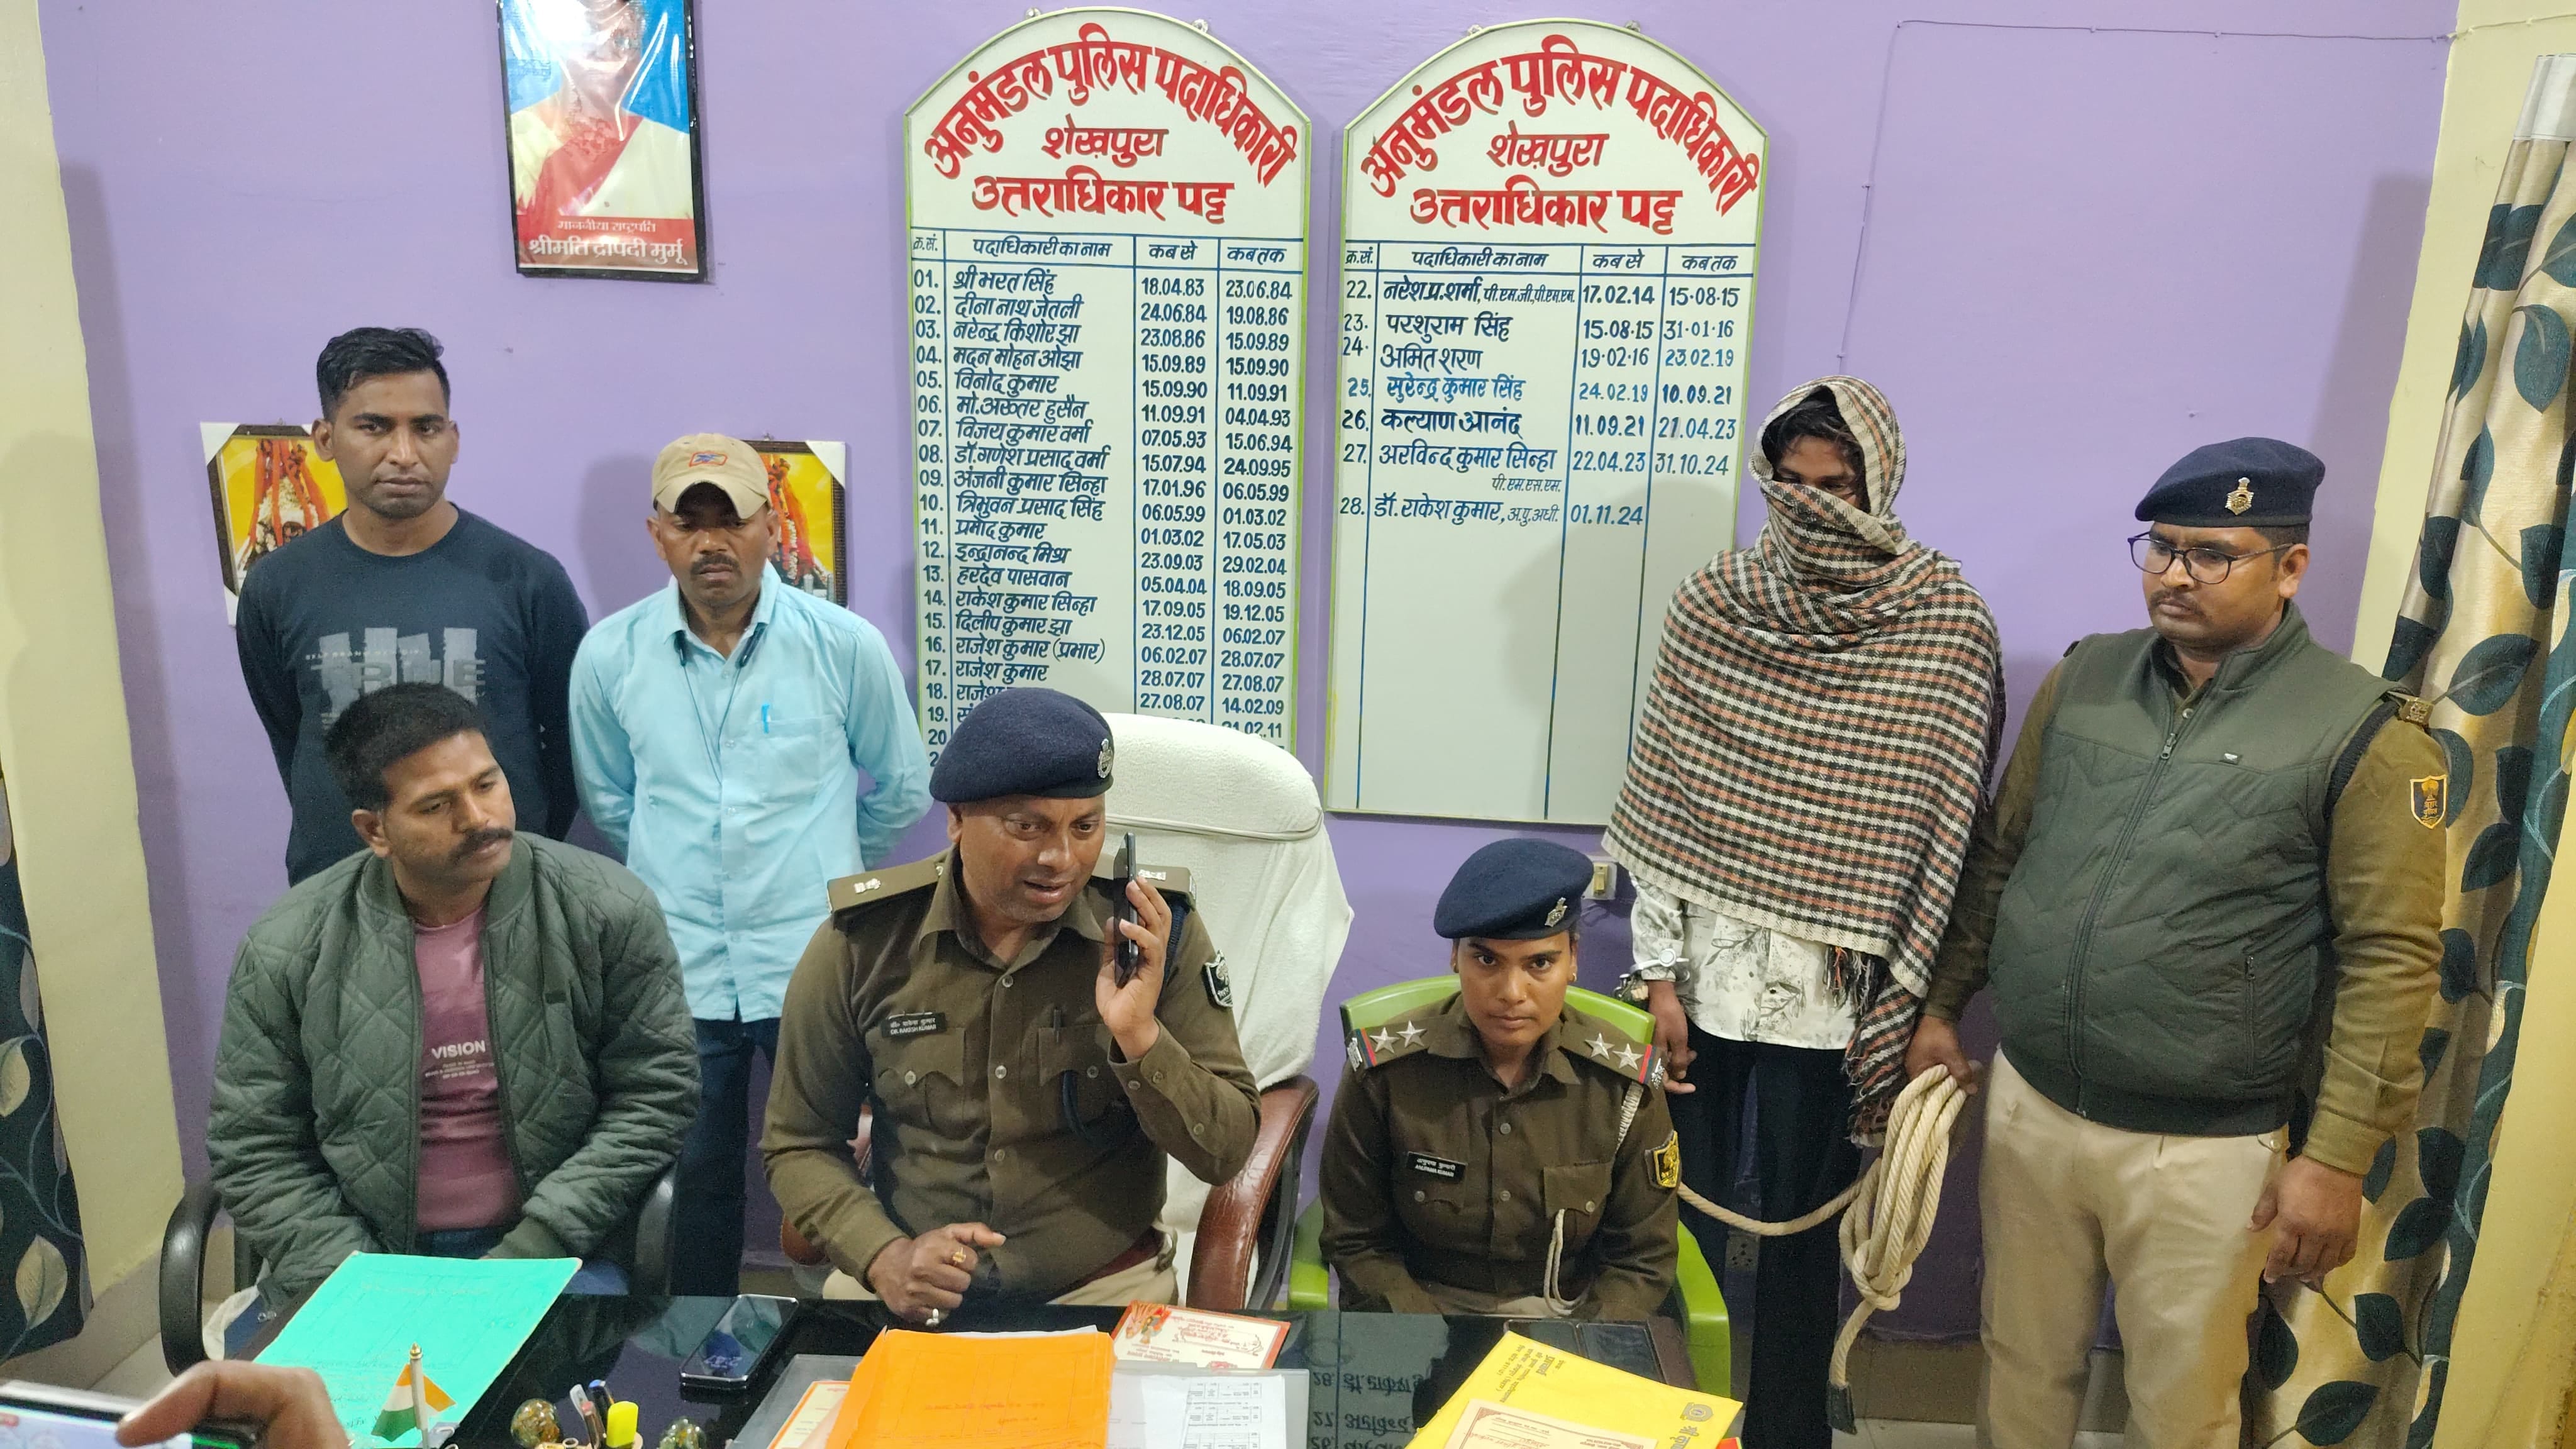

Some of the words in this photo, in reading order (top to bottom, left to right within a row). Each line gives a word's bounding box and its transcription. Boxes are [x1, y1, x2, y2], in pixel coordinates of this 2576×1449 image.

[924, 50, 1054, 180] अनुमंडल
[1046, 23, 1153, 106] पुलिस
[1155, 47, 1297, 187] पदाधिकारी
[1361, 59, 1504, 198] अनुमंडल
[1501, 34, 1629, 118] पुलिस
[1626, 66, 1759, 217] पदाधिकारी
[972, 165, 1169, 221] उत्तराधिकार
[1411, 175, 1613, 233] उत्तराधिकार
[529, 234, 588, 255] श्रीमति
[650, 238, 688, 265] मुर्मू
[973, 235, 1060, 257] पदाधिकारी
[1081, 243, 1113, 257] नाम
[1148, 244, 1180, 259] कब
[1180, 240, 1197, 260] से
[1228, 247, 1258, 262] कब
[1257, 248, 1287, 265] तक
[1412, 247, 1493, 268] पदाधिकारी
[1515, 253, 1549, 267] नाम
[1592, 254, 1626, 268] कब
[1625, 248, 1645, 268] से
[1682, 255, 1713, 270] कब
[1711, 255, 1738, 272] तक
[914, 269, 939, 288] 01.
[953, 265, 977, 289] श्री
[979, 271, 1022, 293] भरत
[1023, 268, 1057, 294] सिंह
[1141, 277, 1204, 296] 18.04.83
[1226, 280, 1292, 299] 23.06.84
[1346, 280, 1372, 299] 22.
[1583, 286, 1655, 304] 17.02.14
[954, 291, 997, 318] दीना
[996, 298, 1035, 316] नाथ
[916, 319, 940, 339] 03.
[953, 318, 1002, 341] नरेन्द्र
[1004, 318, 1057, 343] किशोर
[1056, 325, 1082, 345] झा
[1345, 314, 1368, 331] 23.
[1386, 314, 1468, 343] परशुराम
[1474, 311, 1513, 342] सिंह
[1141, 328, 1206, 348] 23.08.86
[1226, 332, 1289, 352] 15.09.89
[953, 347, 994, 367] मदन
[994, 343, 1038, 370] मोहन
[1038, 345, 1083, 371] ओझा
[1380, 343, 1438, 372] अमित
[1439, 348, 1484, 374] शरण
[1665, 348, 1733, 367] 23.02.19
[916, 370, 941, 389] 05.
[955, 367, 1007, 394] विनोद
[1007, 374, 1060, 397] कुमार
[1142, 380, 1208, 398] 15.09.90
[1348, 377, 1371, 397] 25.
[1387, 372, 1440, 403] सुरेन्द्र
[1441, 378, 1489, 404] कुमार
[1492, 374, 1526, 401] सिंह
[1228, 383, 1287, 402] 11.09.91
[1580, 382, 1648, 402] 24.02.19
[1663, 384, 1731, 404] 10.09.21
[1044, 394, 1089, 424] हुसैन
[1342, 409, 1368, 431] 26.
[1381, 408, 1458, 433] कल्याण
[1459, 407, 1523, 440] आनंद
[1576, 414, 1644, 436] 11.09.21
[1658, 416, 1736, 439] 21.04.23
[956, 416, 1008, 440] विजय
[1006, 423, 1060, 447] कुमार
[1060, 419, 1094, 443] वर्मा
[1024, 449, 1077, 470] प्रसाद
[1075, 445, 1111, 469] वर्मा
[1343, 443, 1367, 464] 27.
[1379, 438, 1456, 470] अरविन्द
[1457, 447, 1504, 473] कुमार
[1506, 441, 1557, 471] सिन्हा
[1573, 450, 1645, 472] 22.04.23
[1655, 453, 1729, 475] 31.10.24
[920, 469, 944, 487] 09.
[954, 465, 1007, 489] अंजनी
[1006, 472, 1057, 496] कुमार
[1058, 470, 1108, 496] सिन्हा
[1143, 479, 1206, 498] 17.01.96
[1223, 482, 1289, 502] 06.05.99
[956, 490, 1019, 518] त्रिभुवन
[1016, 497, 1068, 519] प्रसाद
[1071, 494, 1106, 521] सिंह
[1340, 497, 1365, 515] 28.
[1374, 492, 1397, 517] डॉ.
[1401, 493, 1453, 519] राकेश
[1453, 501, 1504, 525] कुमार,
[1571, 504, 1643, 525] 01.11.24
[998, 521, 1048, 542] कुमार
[924, 565, 944, 582] 13.
[957, 564, 1004, 586] हरदेव
[1008, 569, 1072, 587] पासवान
[1141, 576, 1207, 594] 05.04.04
[1224, 580, 1286, 599] 18.09.05
[956, 586, 1004, 606] राकेश
[1002, 594, 1050, 614] कुमार
[1052, 591, 1097, 616] सिन्हा
[925, 613, 945, 629] 15.
[955, 609, 1003, 633] दिलीप
[1002, 616, 1050, 636] कुमार
[1048, 619, 1072, 636] झा
[1142, 623, 1206, 641] 23.12.05
[956, 633, 1003, 655] राजेश
[1002, 640, 1050, 661] कुमार
[1053, 638, 1105, 664] (प्रभार)
[925, 660, 947, 675] 17.
[956, 657, 1003, 679] राजेश
[1002, 663, 1049, 684] कुमार
[1141, 670, 1205, 688] 28.07.07
[1222, 674, 1284, 692] 27.08.07
[431, 1040, 486, 1059] VISION
